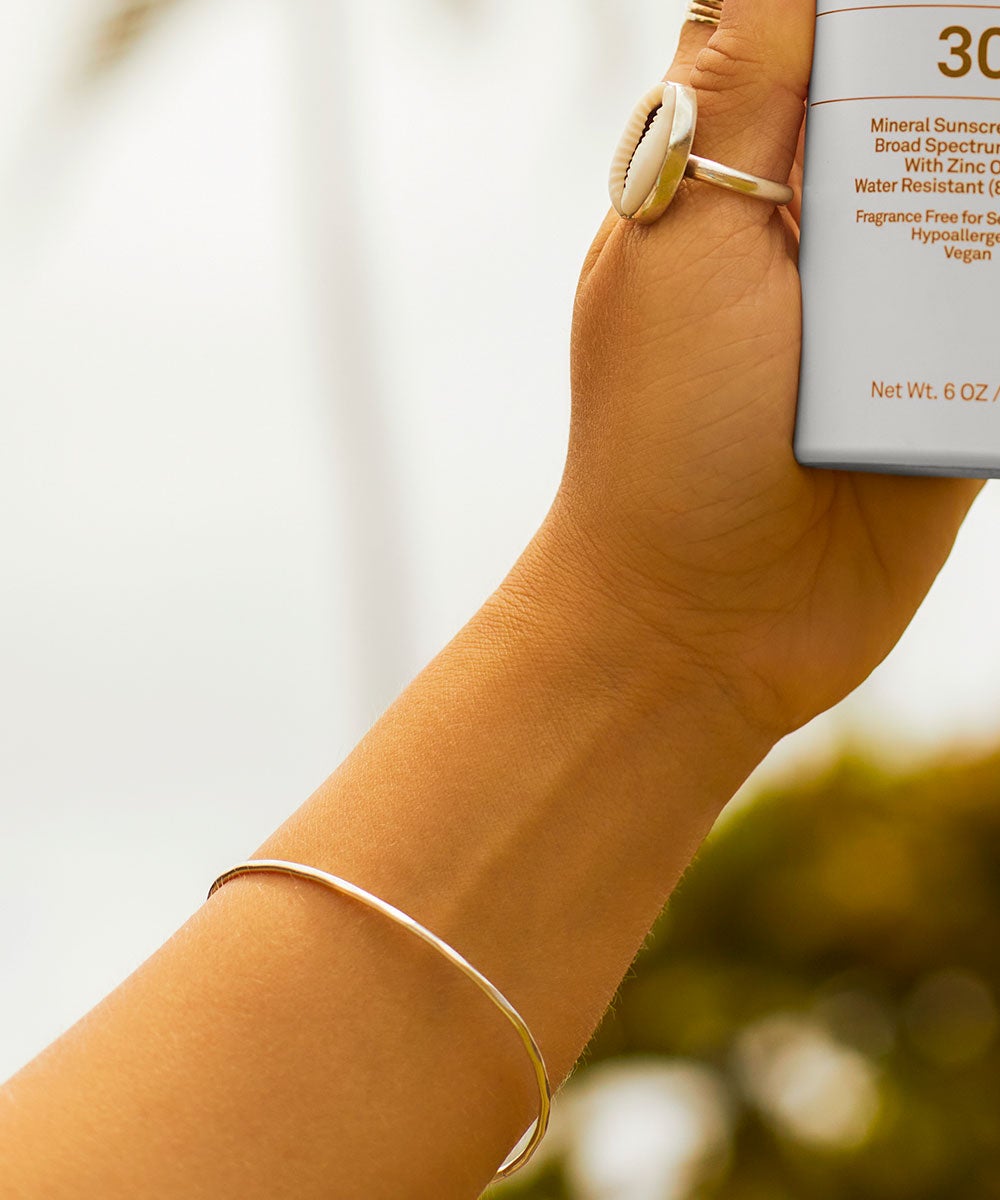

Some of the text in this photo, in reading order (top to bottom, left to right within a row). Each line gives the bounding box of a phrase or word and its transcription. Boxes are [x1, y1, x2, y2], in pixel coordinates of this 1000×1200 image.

[870, 117, 930, 134] Mineral
[874, 137, 922, 153] Broad
[904, 157, 943, 173] With
[947, 158, 986, 175] Zinc
[854, 177, 898, 193] Water
[900, 178, 984, 195] Resistant
[855, 209, 922, 228] Fragrance
[925, 209, 959, 224] Free
[962, 210, 984, 225] for
[943, 246, 992, 264] Vegan
[871, 380, 903, 399] Net
[906, 380, 938, 400] Wt.
[943, 382, 955, 400] 6
[959, 383, 989, 402] OZ
